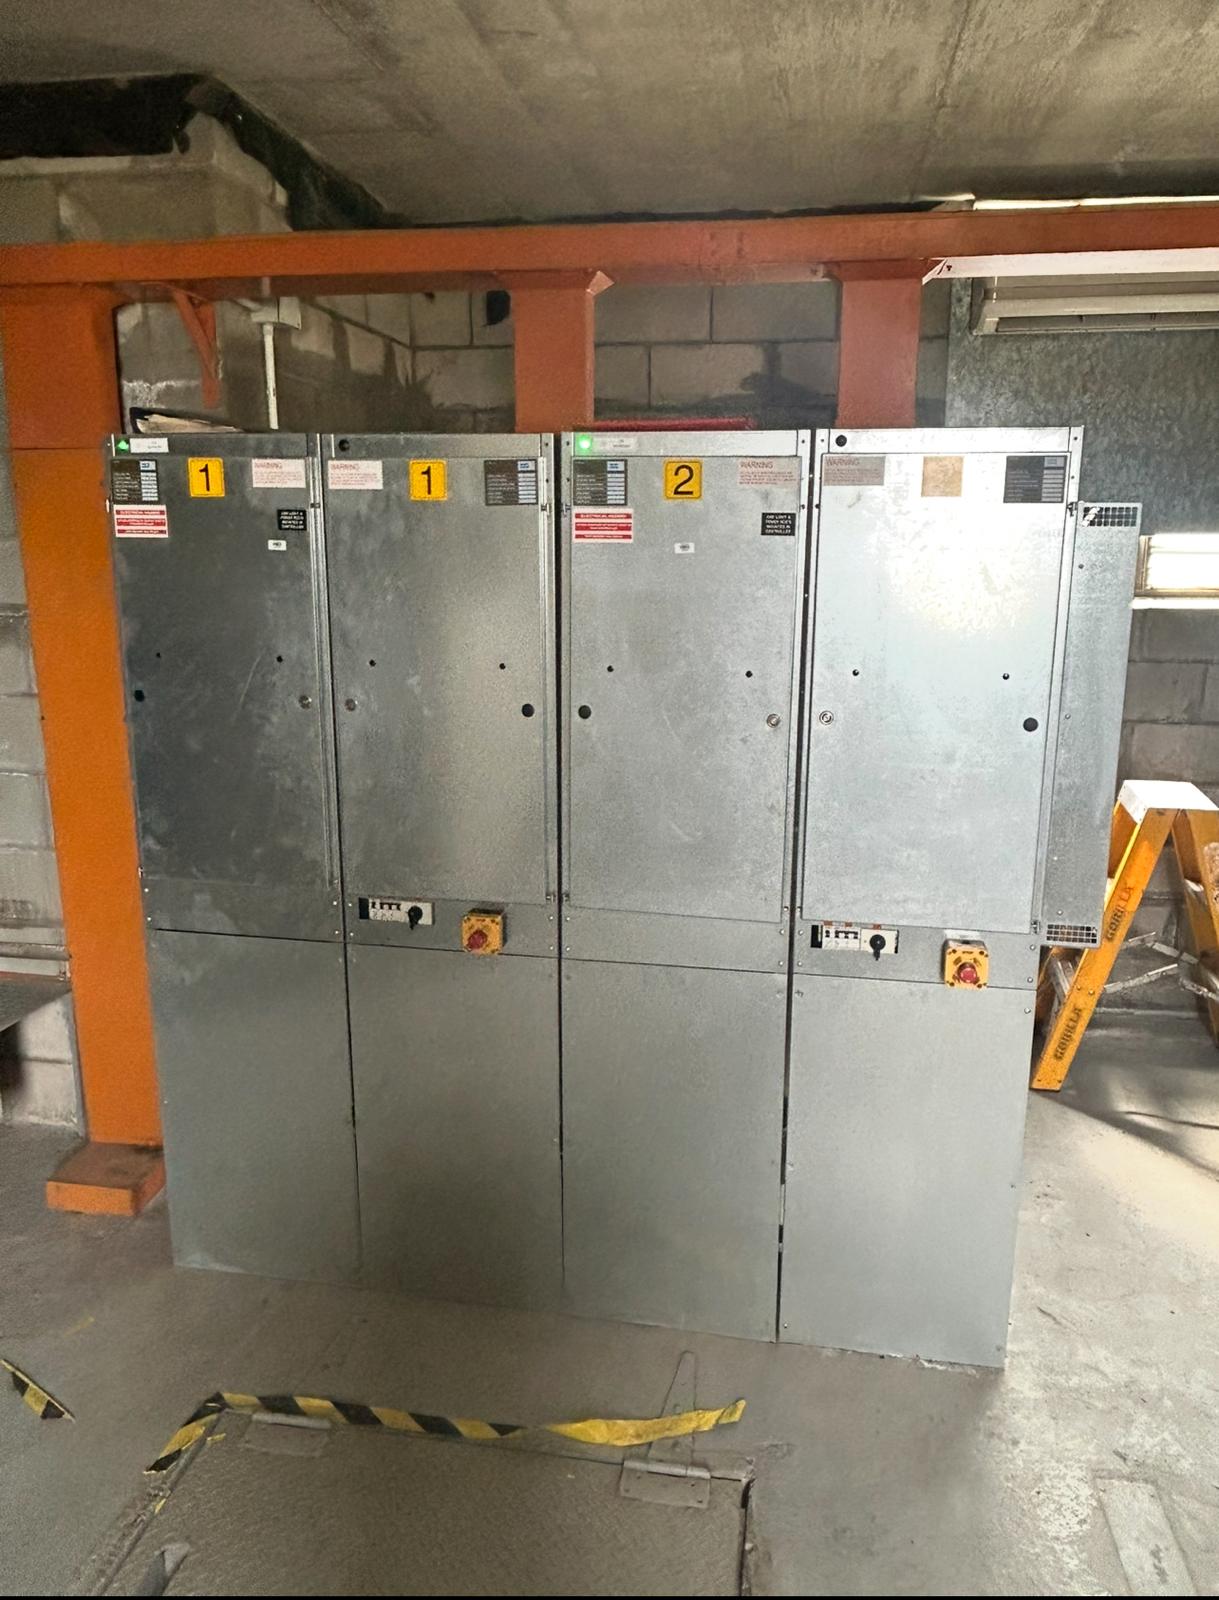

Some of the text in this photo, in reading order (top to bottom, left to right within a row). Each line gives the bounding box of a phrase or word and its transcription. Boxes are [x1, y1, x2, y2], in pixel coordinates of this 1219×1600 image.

[199, 463, 211, 492] 1
[331, 463, 360, 471] WARNING
[421, 465, 432, 495] 1
[673, 464, 695, 496] 2
[740, 461, 774, 469] WARNING
[1106, 886, 1134, 942] GORILLA
[1054, 1007, 1083, 1062] GORILLA
